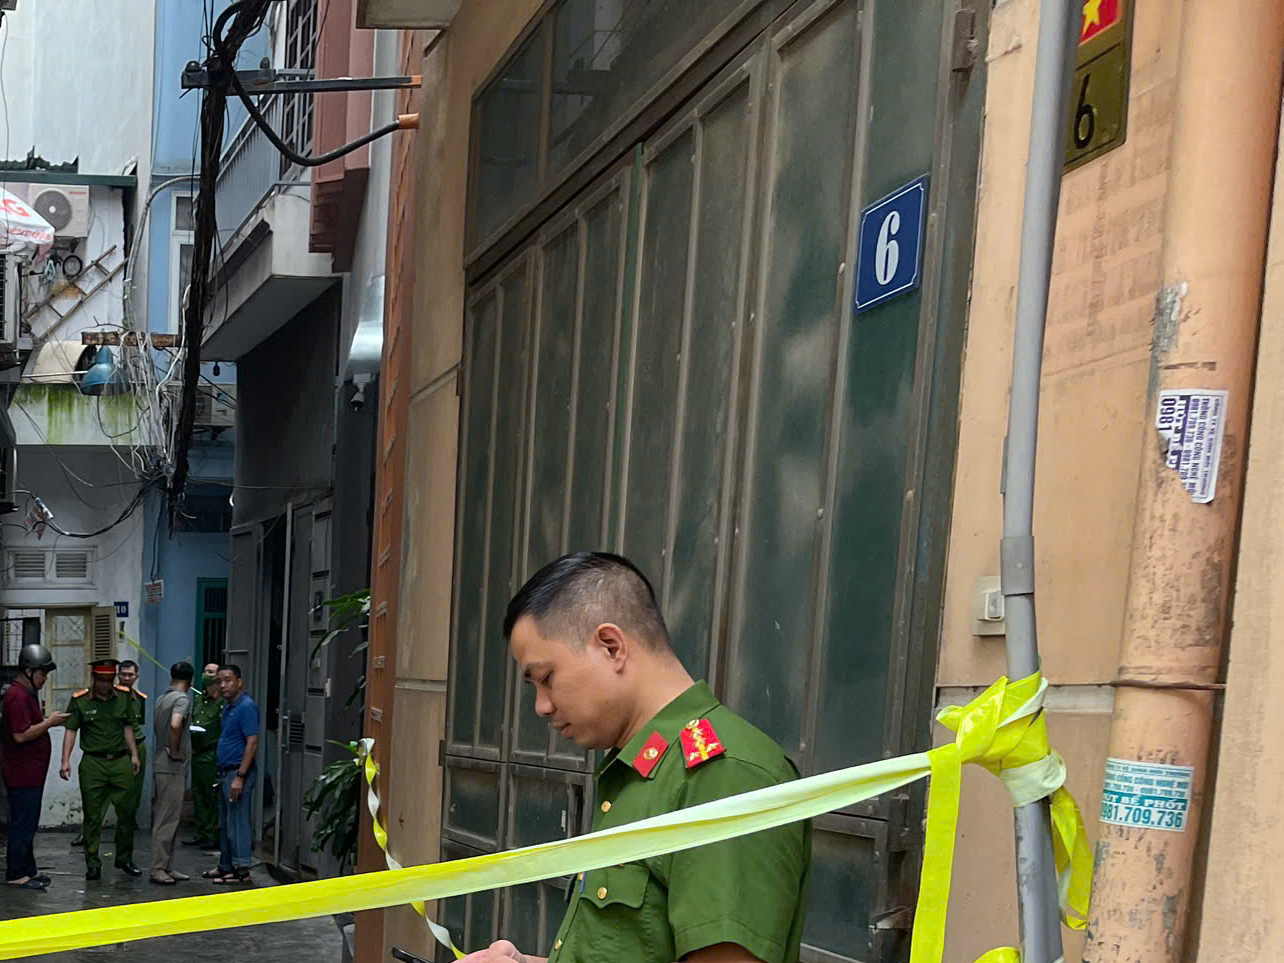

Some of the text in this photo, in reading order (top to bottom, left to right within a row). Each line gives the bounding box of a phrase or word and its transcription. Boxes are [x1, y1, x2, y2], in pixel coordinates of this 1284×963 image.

[1074, 73, 1095, 150] 6
[874, 210, 901, 286] 6
[116, 605, 127, 614] 10
